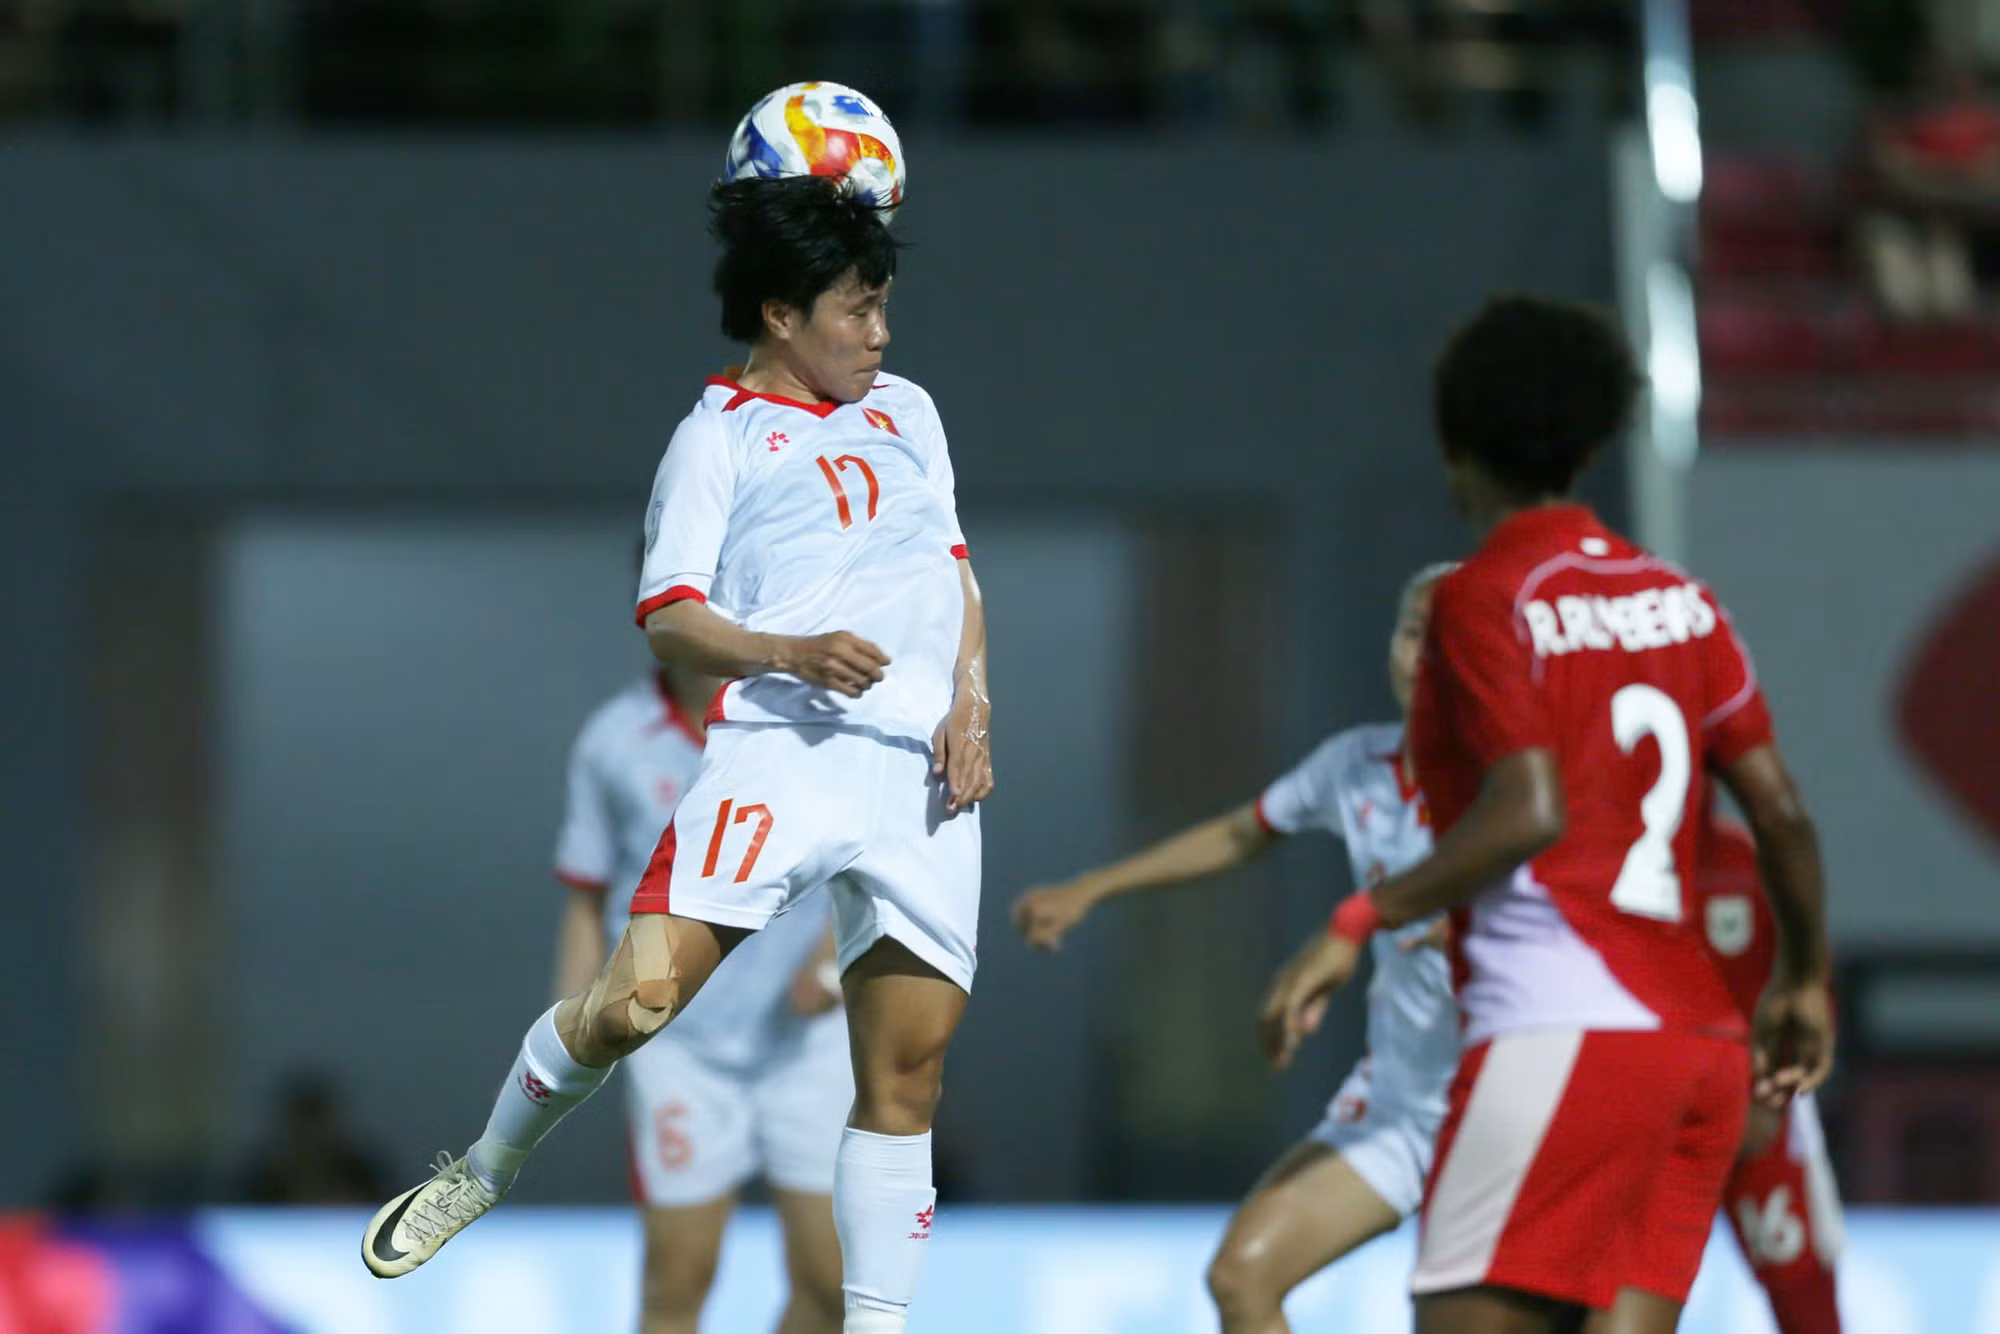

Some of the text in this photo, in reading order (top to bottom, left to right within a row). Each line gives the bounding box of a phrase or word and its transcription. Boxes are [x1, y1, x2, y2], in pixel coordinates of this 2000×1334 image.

[816, 455, 879, 530] 17
[701, 798, 774, 884] 17
[1609, 683, 1691, 923] 2
